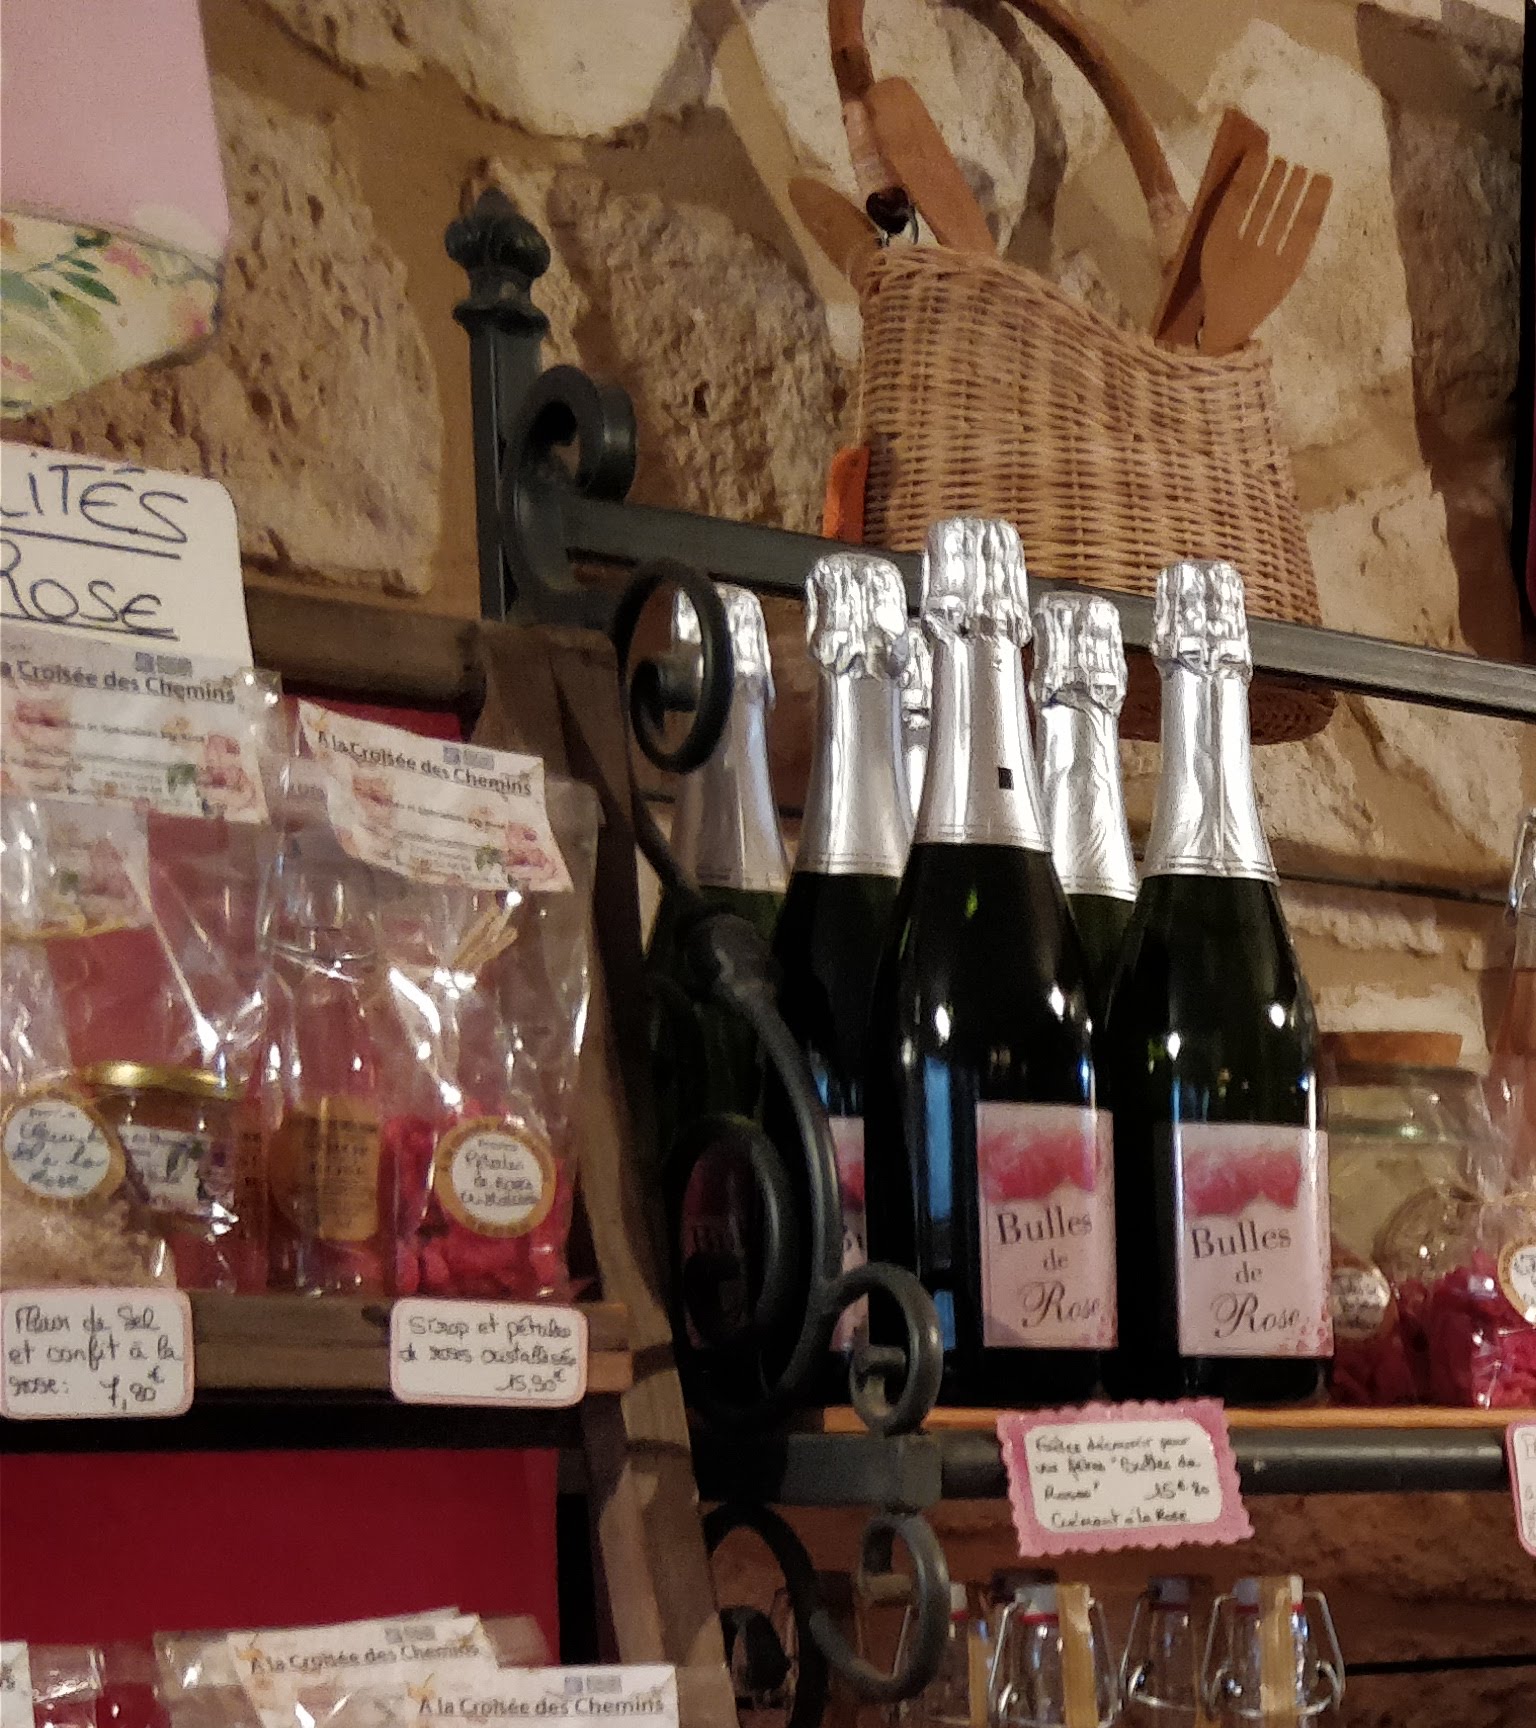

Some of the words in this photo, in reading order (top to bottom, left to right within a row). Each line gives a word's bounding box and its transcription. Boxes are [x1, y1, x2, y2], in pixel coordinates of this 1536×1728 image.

[996, 1205, 1092, 1247] Bulles
[1190, 1220, 1293, 1261] Bulles
[1042, 1247, 1069, 1272] de
[1234, 1261, 1263, 1285] de
[437, 1698, 454, 1717] la
[459, 1698, 531, 1718] Croisée
[535, 1697, 569, 1716] des
[573, 1695, 666, 1716] Chemins
